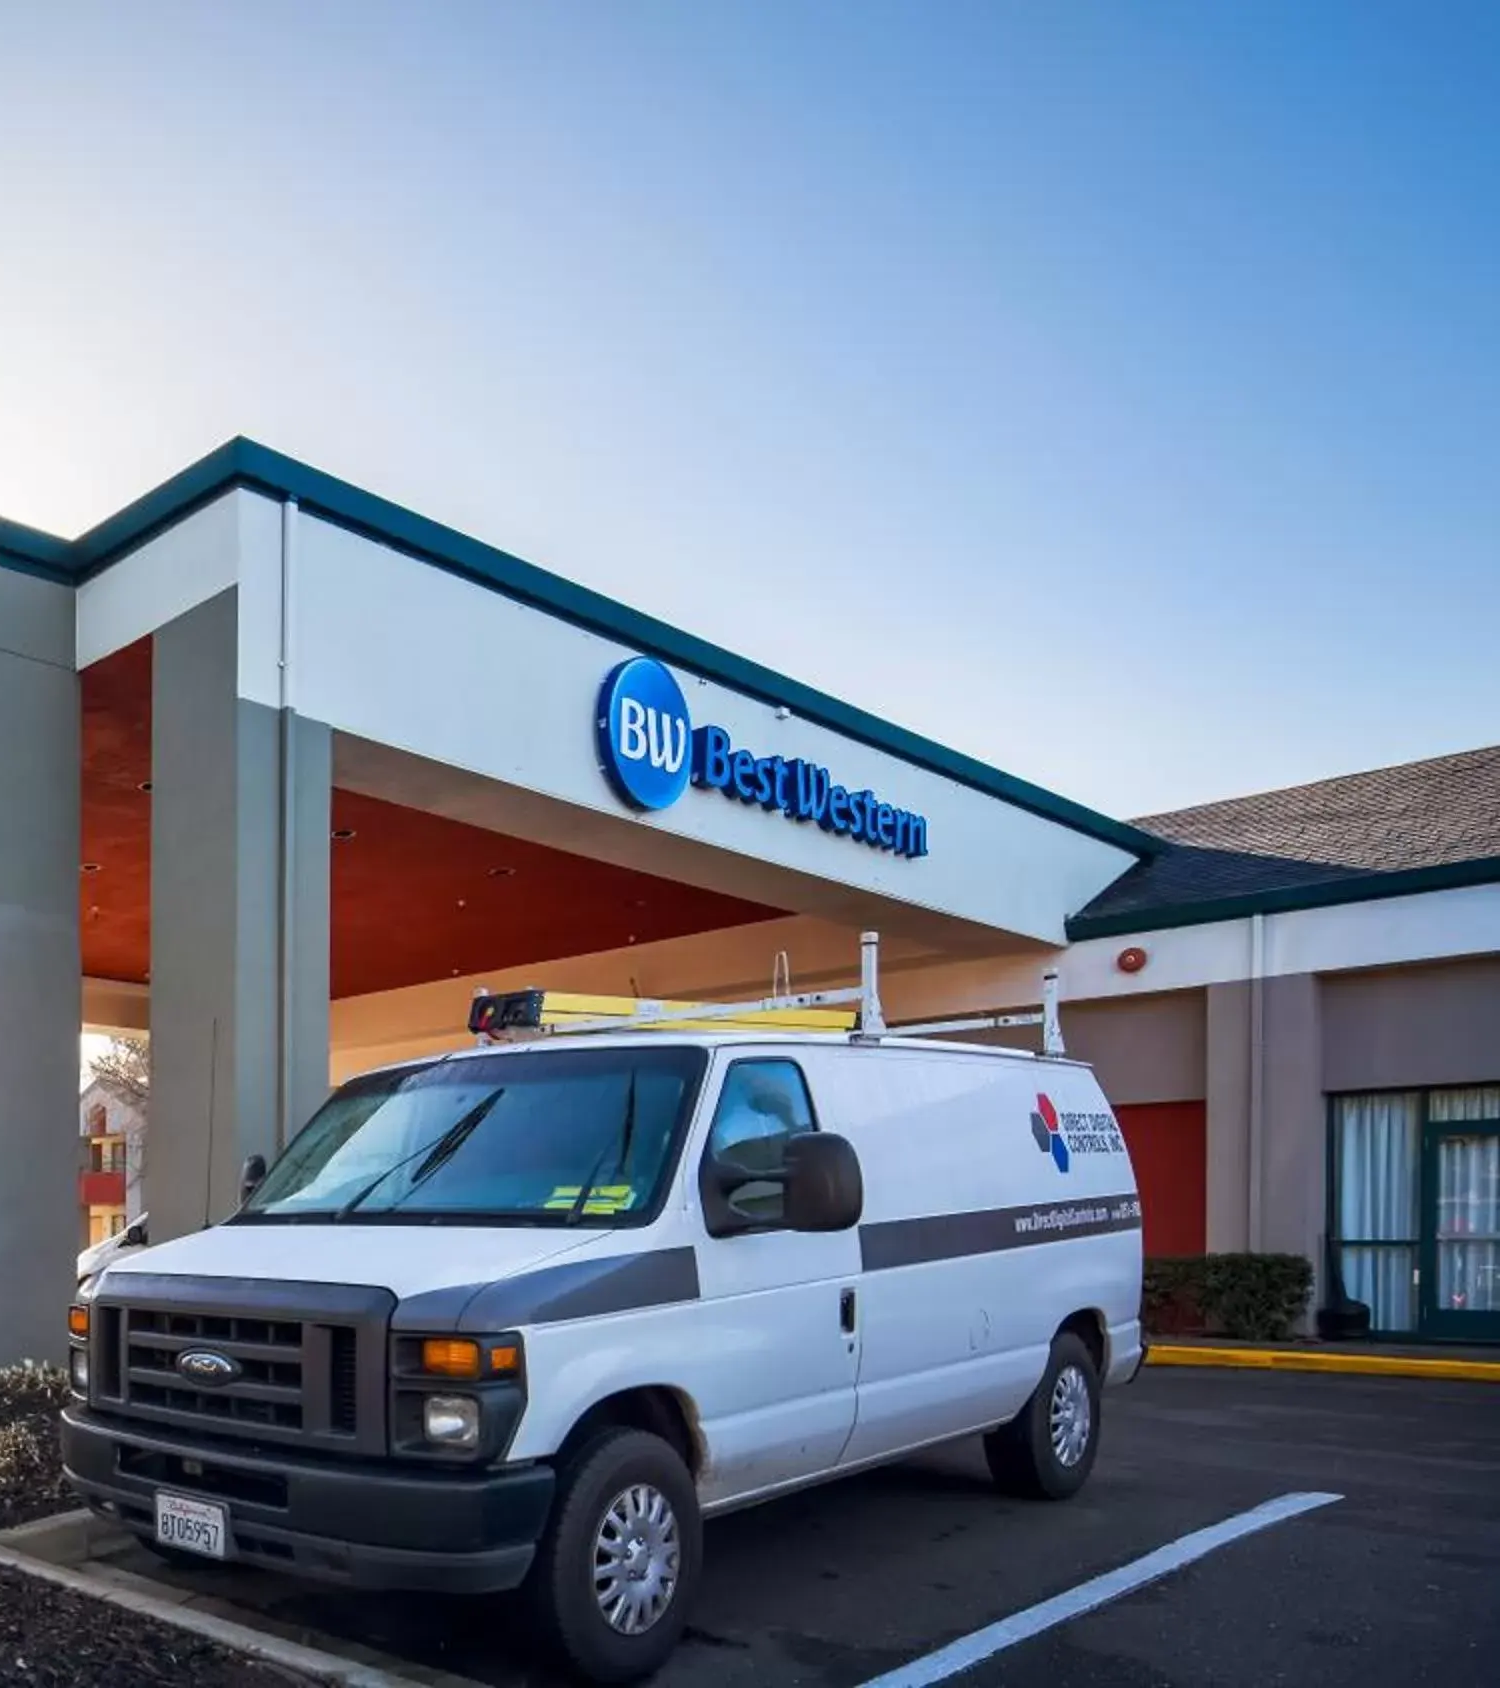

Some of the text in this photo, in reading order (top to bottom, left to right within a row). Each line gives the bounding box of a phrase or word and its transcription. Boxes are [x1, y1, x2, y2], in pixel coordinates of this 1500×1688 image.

[619, 697, 687, 774] BW
[696, 724, 928, 859] Best Western
